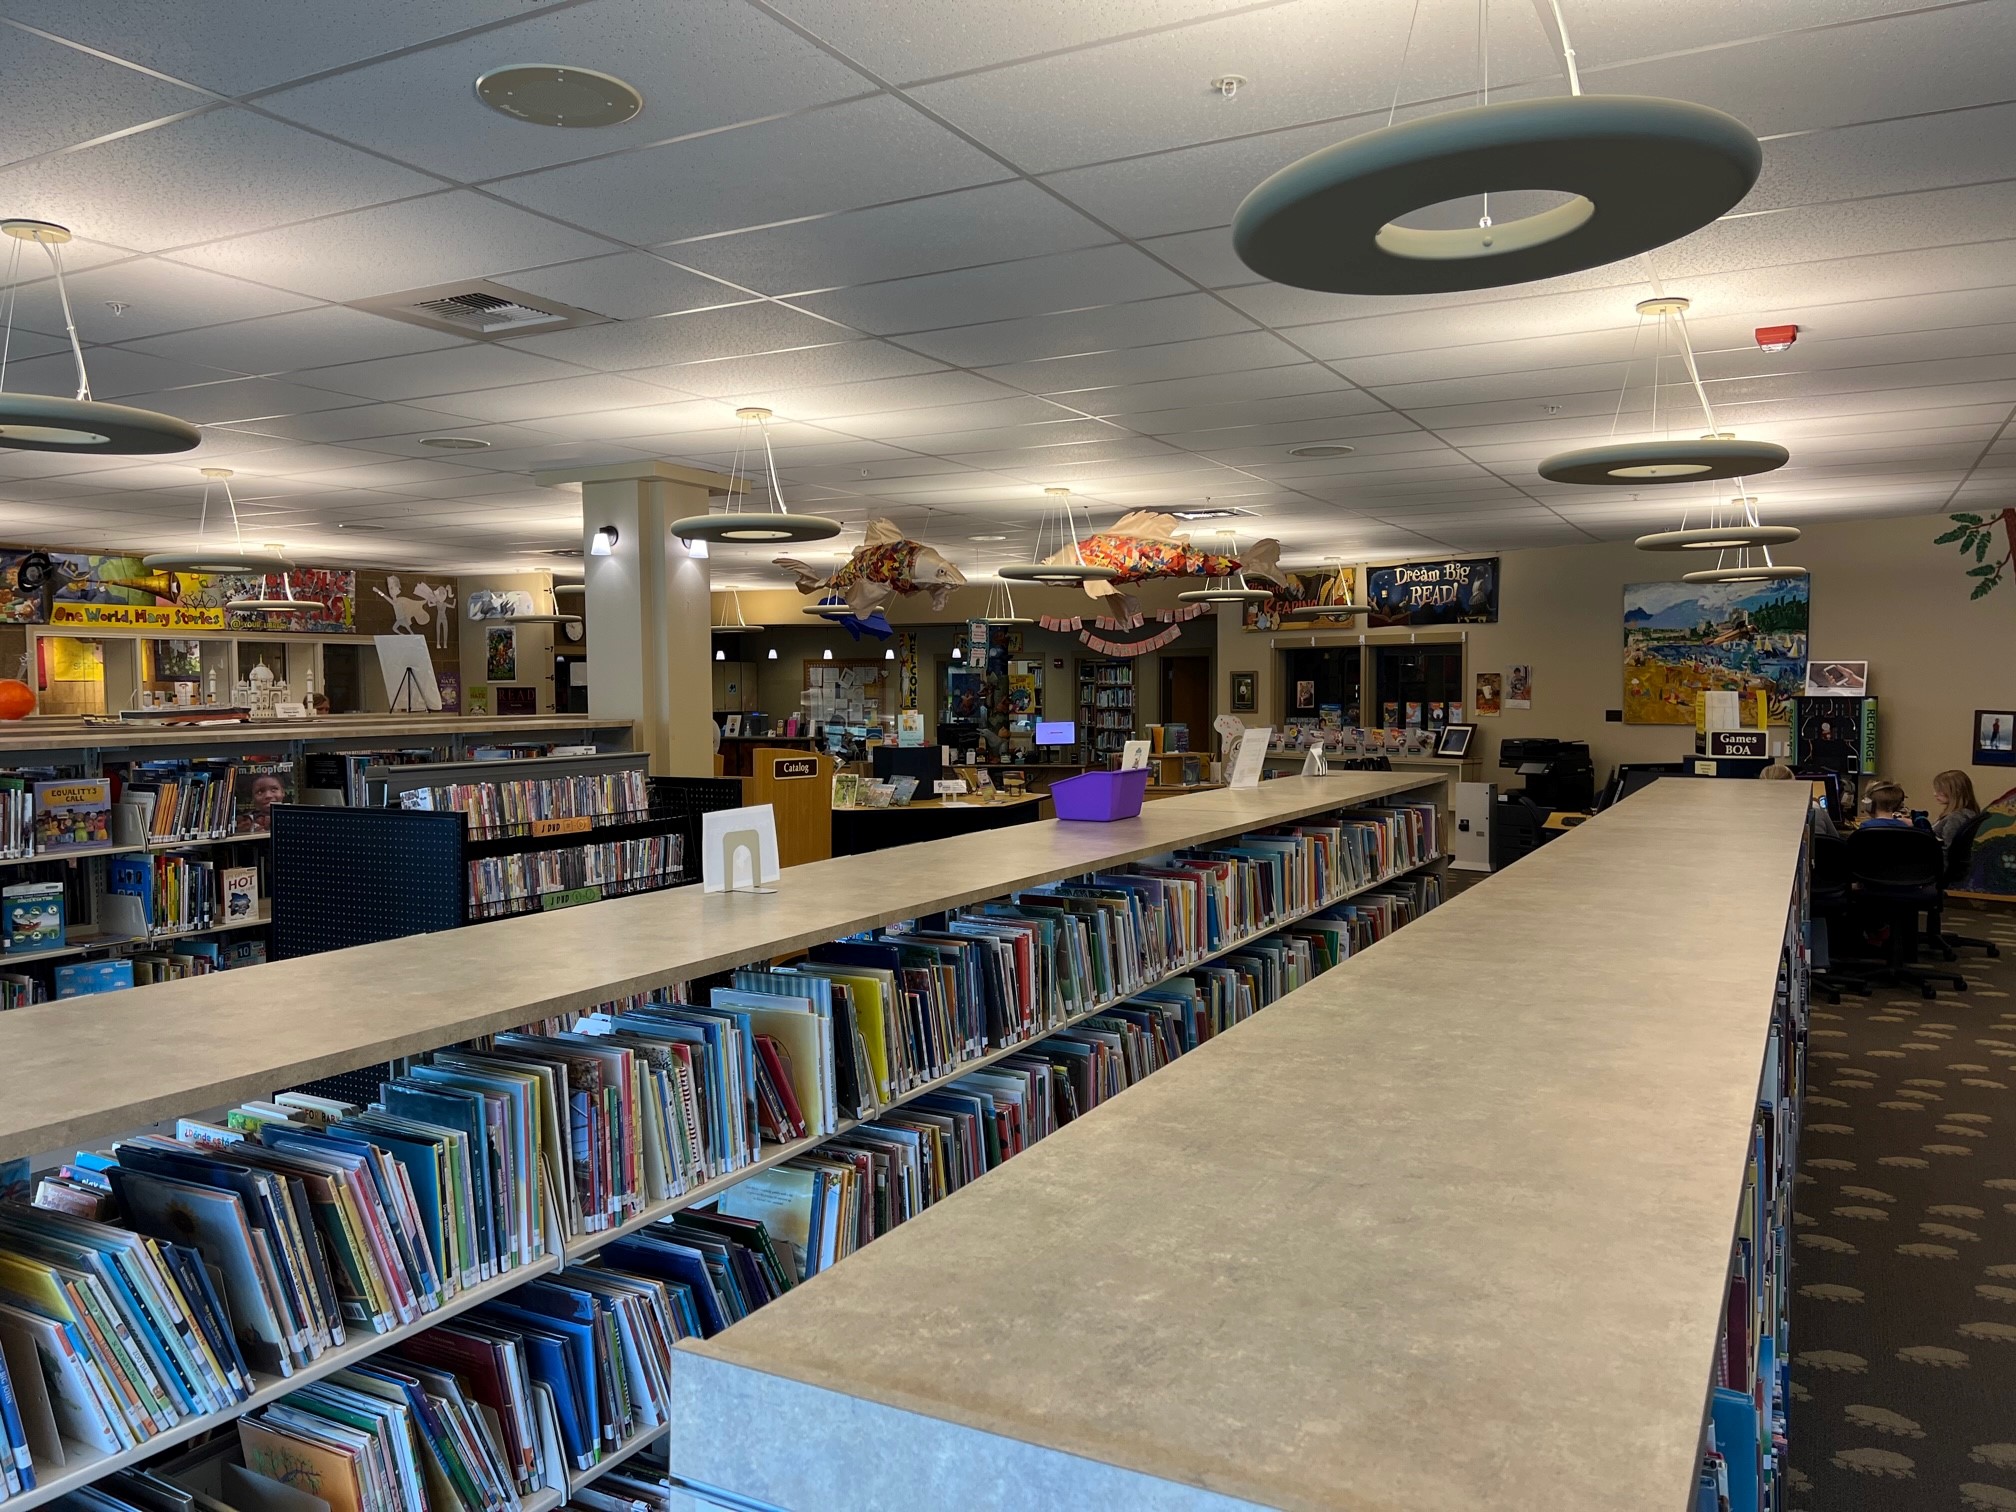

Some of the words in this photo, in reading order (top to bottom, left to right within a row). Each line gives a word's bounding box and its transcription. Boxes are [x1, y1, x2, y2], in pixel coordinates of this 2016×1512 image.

[1394, 568, 1440, 586] Dream
[1443, 563, 1471, 584] Big
[1409, 582, 1459, 608] READ!
[54, 606, 84, 623] One
[84, 608, 133, 625] World,
[135, 609, 170, 628] Many
[174, 609, 220, 625] Stories
[907, 632, 918, 708] WELCOME
[499, 689, 535, 700] READ
[1719, 733, 1757, 744] Games
[1865, 708, 1876, 763] RECHARGE
[1725, 745, 1752, 755] BOA
[783, 762, 809, 774] Catalog
[51, 787, 97, 796] EQUALITY'S
[228, 875, 255, 891] HOT
[238, 946, 250, 957] 10
[132, 1349, 143, 1363] ZOO
[139, 1362, 150, 1375] DAY
[1, 1384, 14, 1404] JOHN
